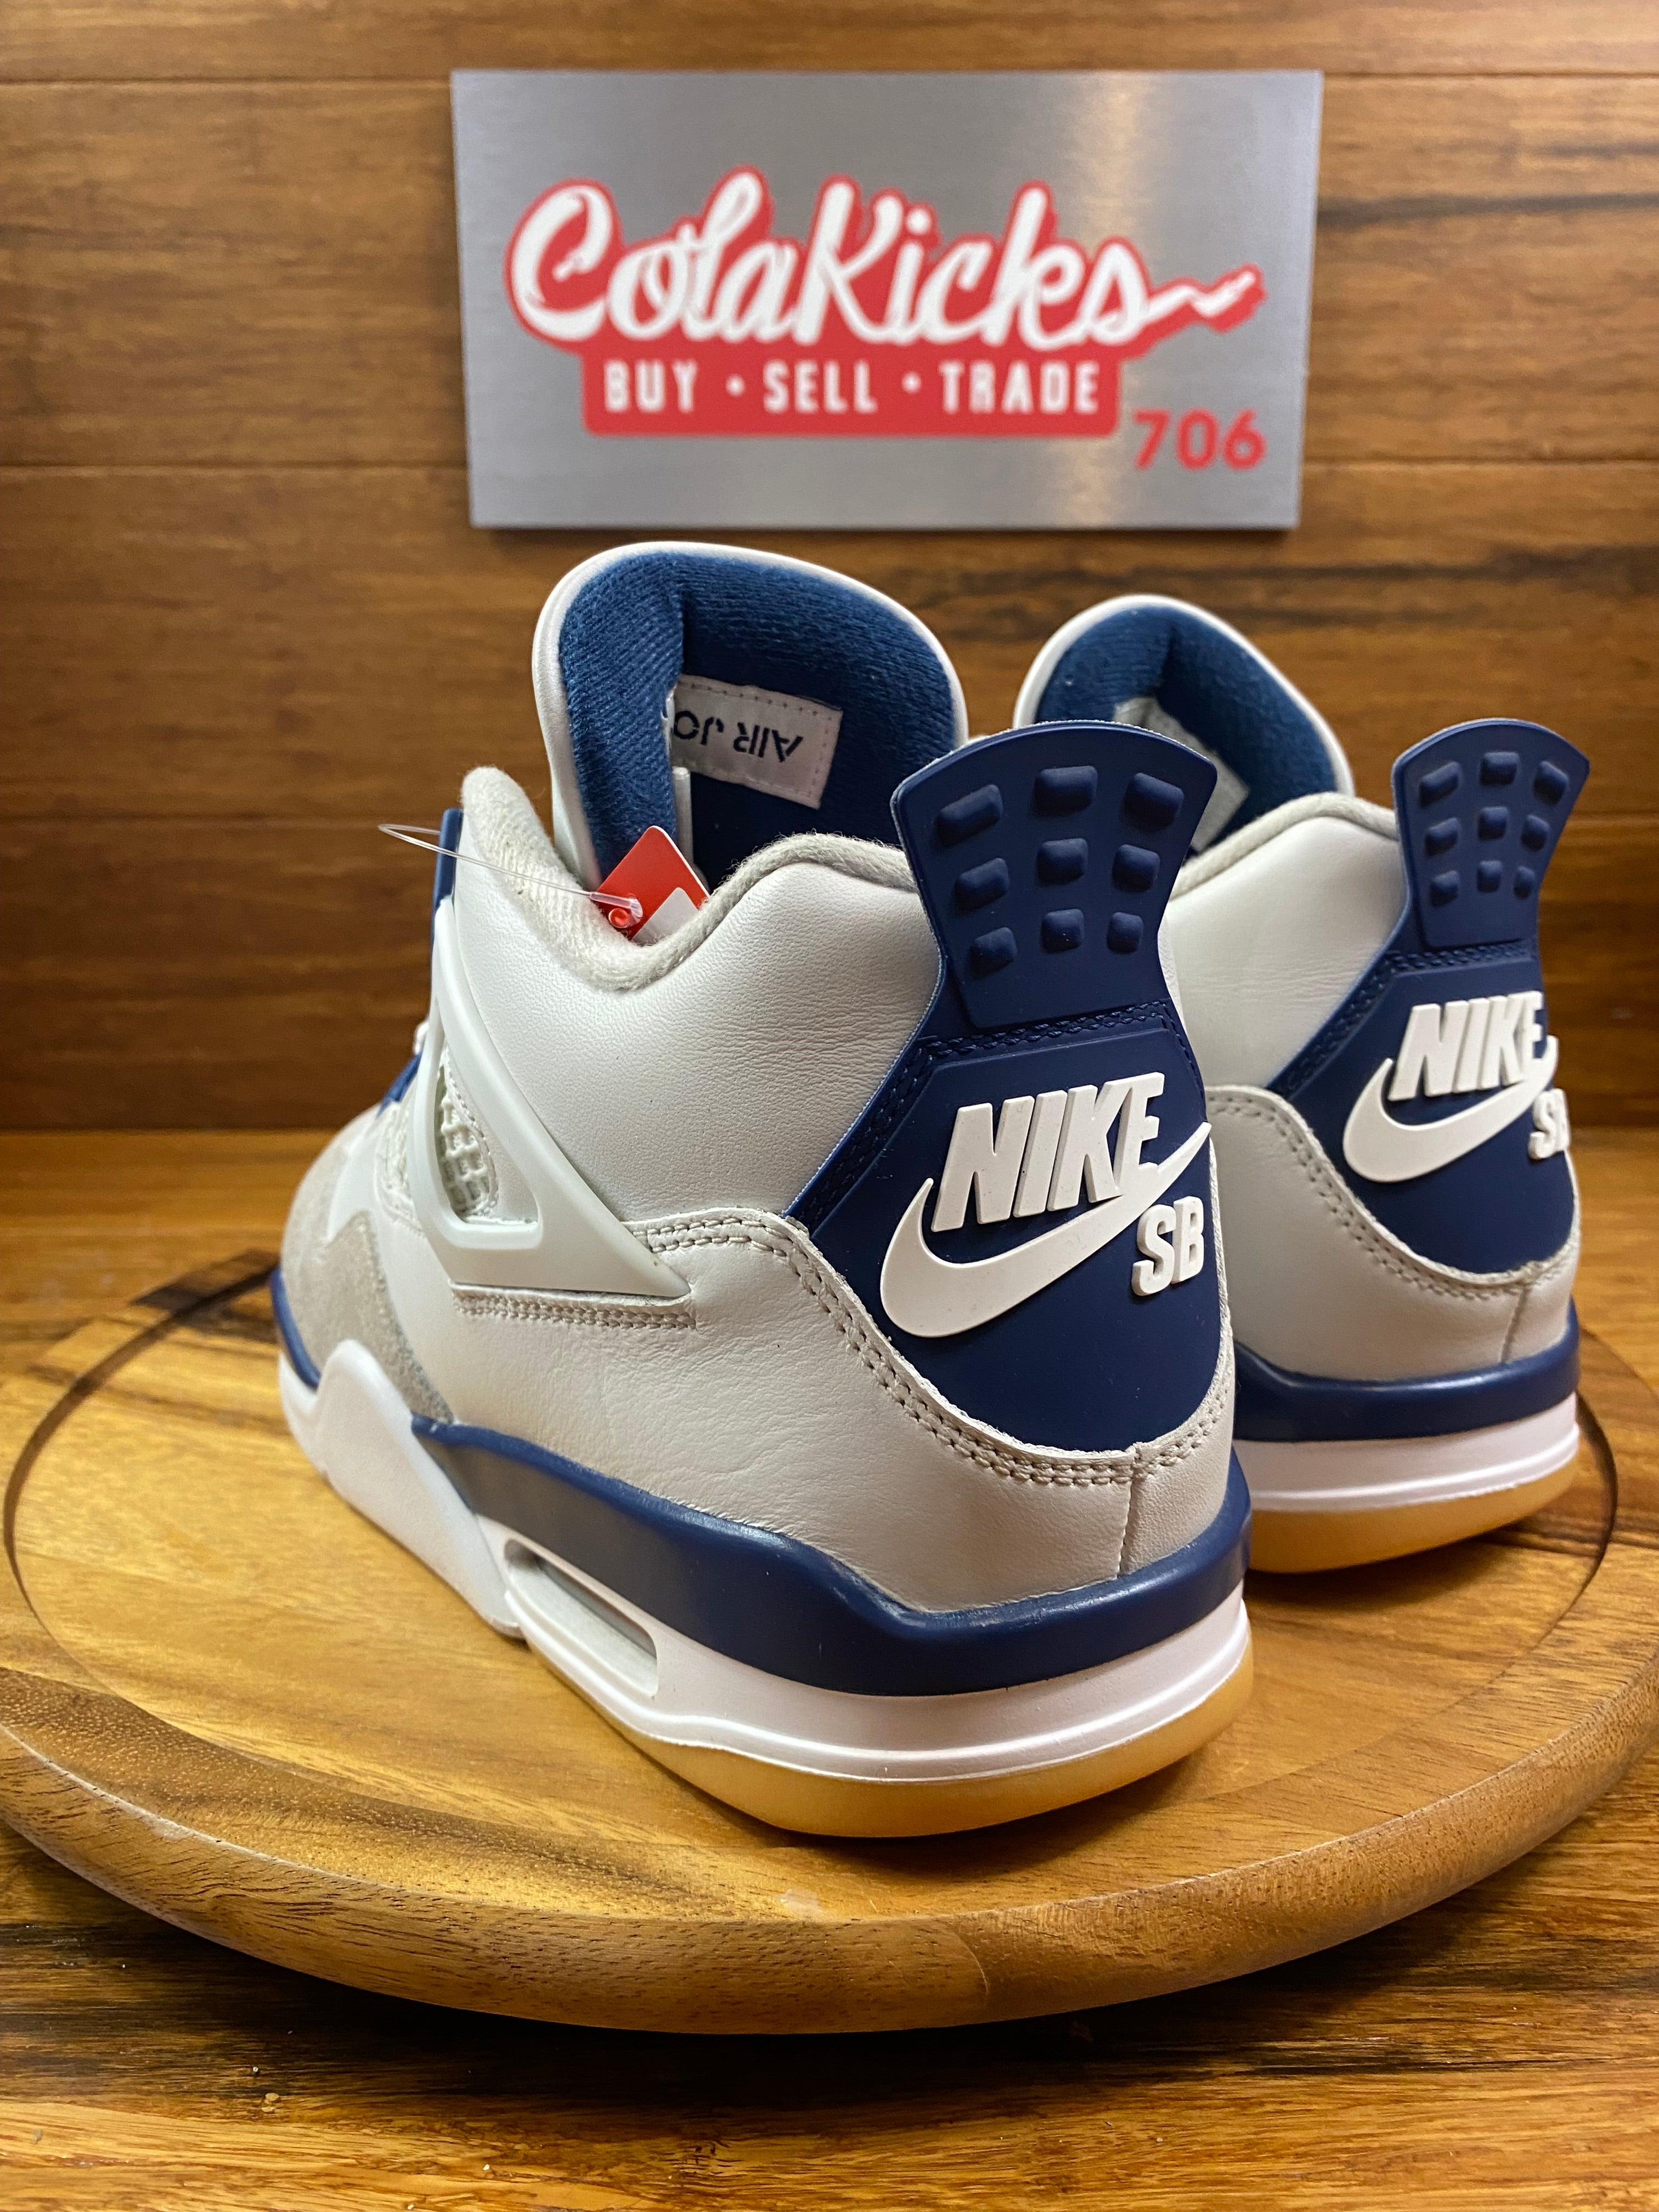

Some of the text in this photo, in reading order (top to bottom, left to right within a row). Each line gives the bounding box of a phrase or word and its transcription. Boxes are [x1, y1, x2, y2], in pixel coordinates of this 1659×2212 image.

[509, 168, 1259, 350] ColaKicks
[603, 359, 1099, 415] BUY SELL TRADE
[1135, 410, 1266, 470] 706
[733, 722, 804, 763] AIR
[1387, 990, 1544, 1102] NIKE
[932, 1071, 1165, 1233] NIKE
[1131, 1195, 1204, 1296] SB
